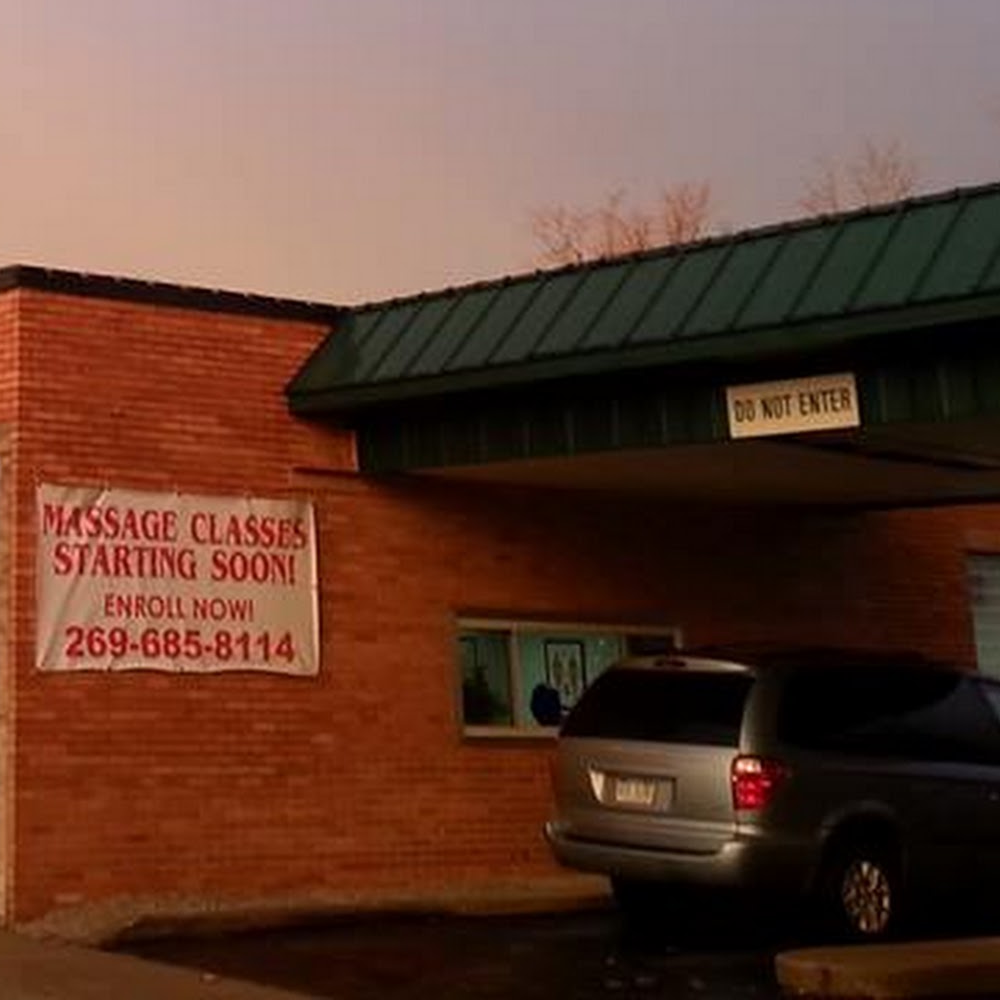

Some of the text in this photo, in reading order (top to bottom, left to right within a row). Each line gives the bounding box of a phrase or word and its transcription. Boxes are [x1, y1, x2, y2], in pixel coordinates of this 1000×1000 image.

[734, 387, 850, 423] DO NOT ENTER
[42, 504, 309, 550] MASSAGE CLASSES
[54, 541, 296, 586] STARTING SOON!
[103, 593, 255, 622] ENROLL NOW!
[65, 626, 296, 663] 269-685-8114
